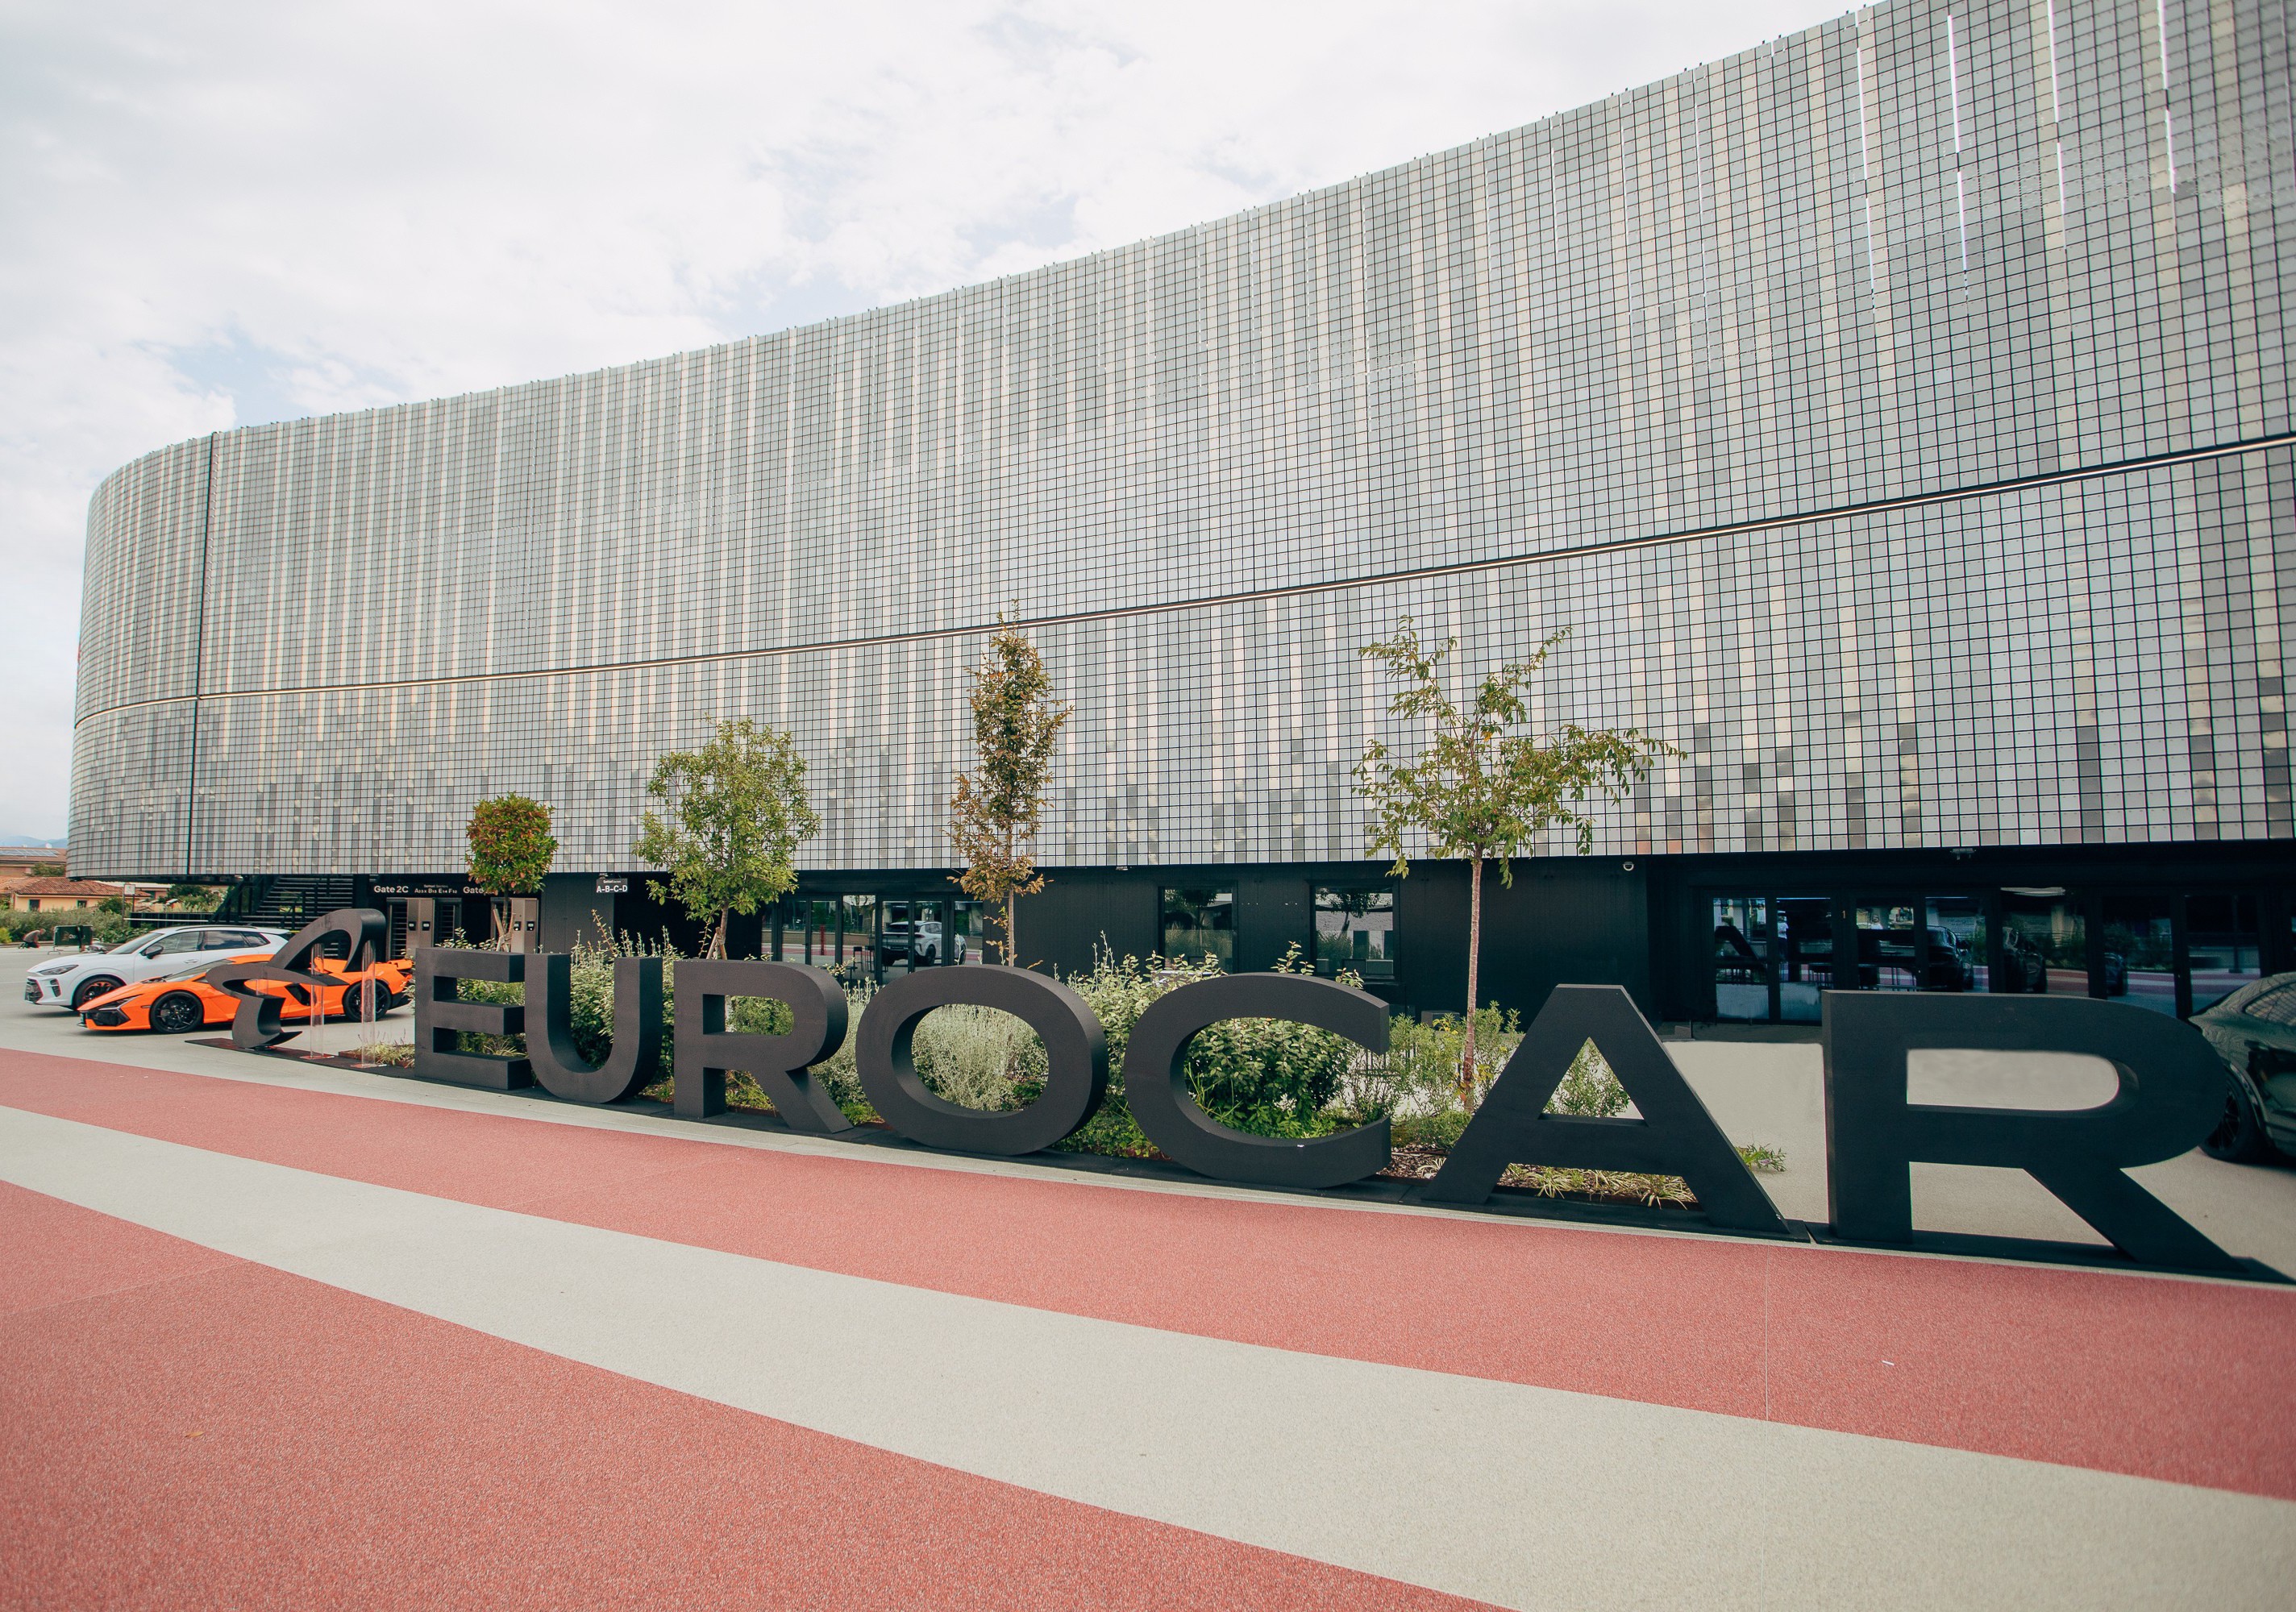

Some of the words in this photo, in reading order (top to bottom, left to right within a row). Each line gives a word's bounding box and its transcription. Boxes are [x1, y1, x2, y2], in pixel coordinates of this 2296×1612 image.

[373, 885, 395, 893] Gate
[396, 885, 409, 893] 2C
[414, 948, 2248, 1273] EUROCAR
